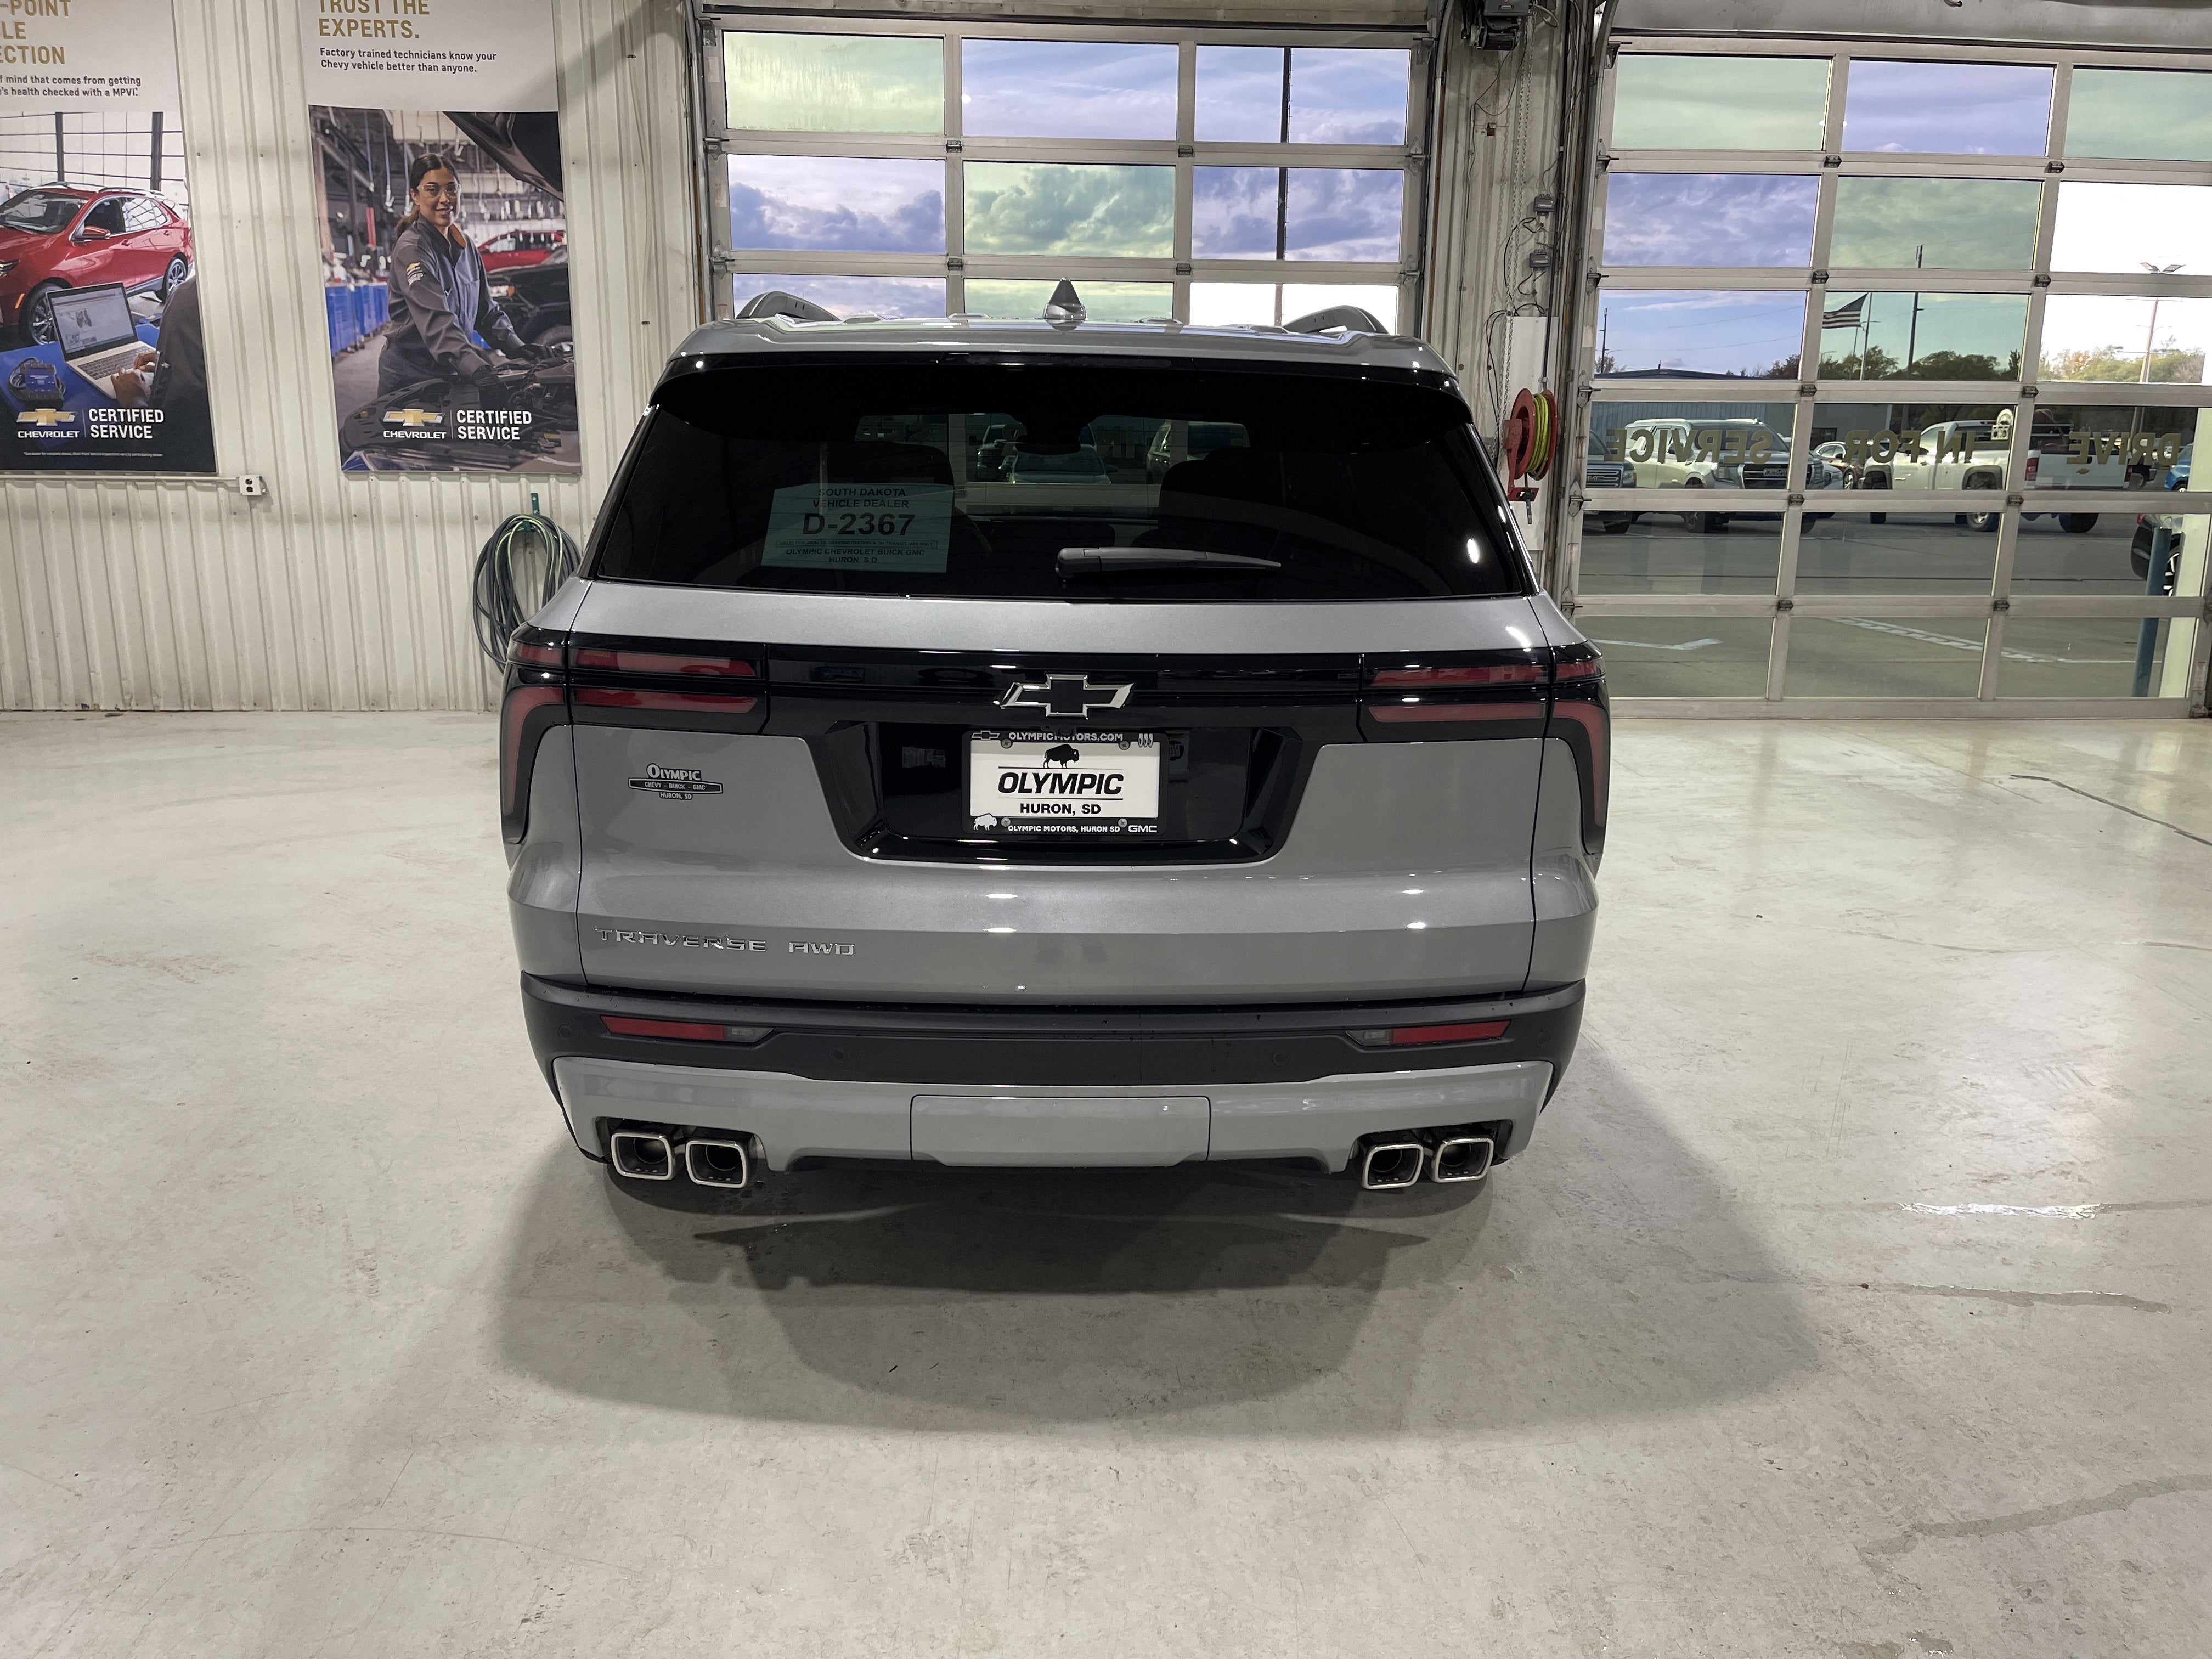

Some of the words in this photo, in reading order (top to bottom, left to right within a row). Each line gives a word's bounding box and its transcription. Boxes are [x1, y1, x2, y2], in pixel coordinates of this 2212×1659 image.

[319, 19, 420, 39] EXPERTS.
[320, 48, 356, 59] Factory
[358, 49, 391, 59] trained
[393, 49, 446, 60] technicians
[449, 51, 473, 60] know
[476, 53, 496, 62] your
[321, 60, 349, 70] Chevy
[352, 60, 383, 70] vehicle
[387, 62, 415, 71] better
[418, 63, 438, 72] than
[442, 64, 477, 74] anyone.
[6, 75, 28, 84] mind
[31, 75, 49, 84] that
[84, 76, 106, 84] from
[109, 76, 141, 86] getting
[11, 87, 40, 96] health
[43, 88, 79, 97] checked
[82, 88, 103, 97] with
[89, 408, 164, 423] CERTIFIED
[456, 410, 532, 424] CERTIFIED
[18, 430, 80, 438] CHEVROLET
[91, 424, 153, 439] SERVICE
[383, 430, 447, 439] CHEVROLET
[458, 426, 520, 440] SERVICE
[818, 488, 856, 496] SOUTH
[860, 488, 906, 496] DAKOTA
[813, 499, 860, 508] VEHICLE
[864, 500, 909, 508] DEALER
[802, 512, 916, 536] D-2367
[998, 772, 1124, 795] OLYMPIC
[1020, 803, 1076, 815] HURON,
[1081, 804, 1101, 814] SD
[1043, 825, 1079, 833] MOTORS,
[1128, 825, 1158, 833] GMC
[595, 928, 767, 952] TRAVERSE
[788, 941, 855, 956] AWD
